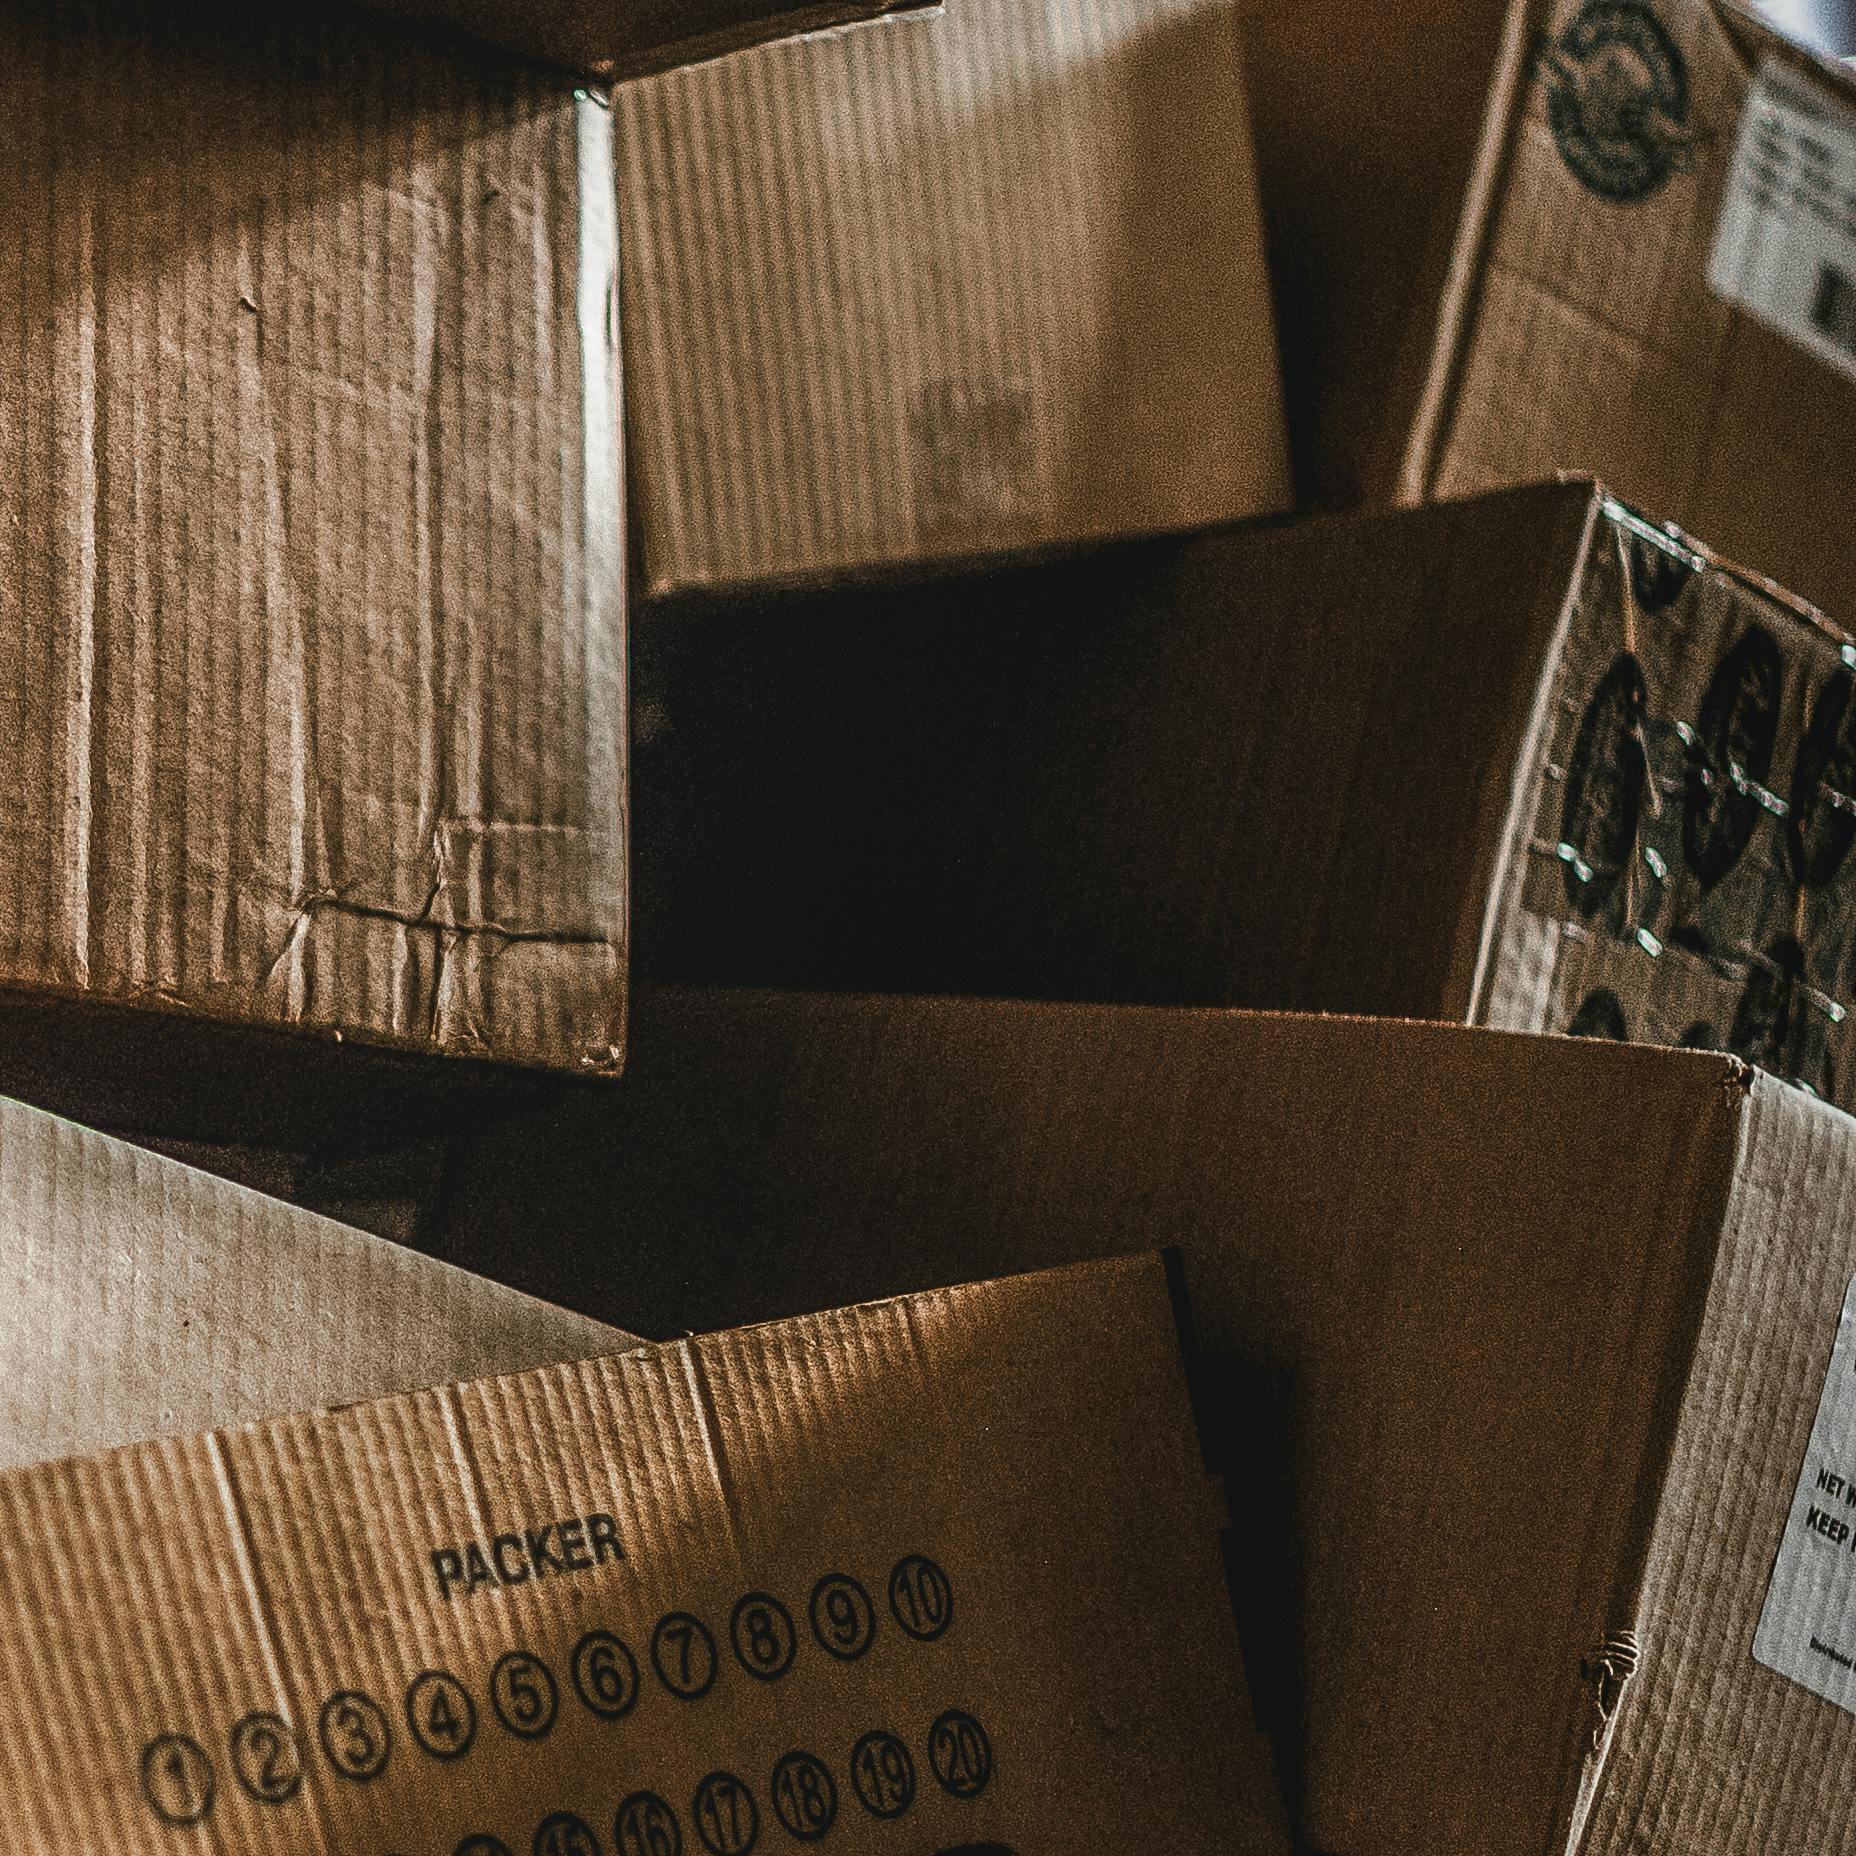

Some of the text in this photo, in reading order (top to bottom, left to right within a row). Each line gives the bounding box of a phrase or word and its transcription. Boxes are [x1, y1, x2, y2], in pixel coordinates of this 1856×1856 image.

[1817, 1467, 1846, 1500] NET
[1806, 1505, 1850, 1545] KEEP
[432, 1512, 628, 1600] PACKER
